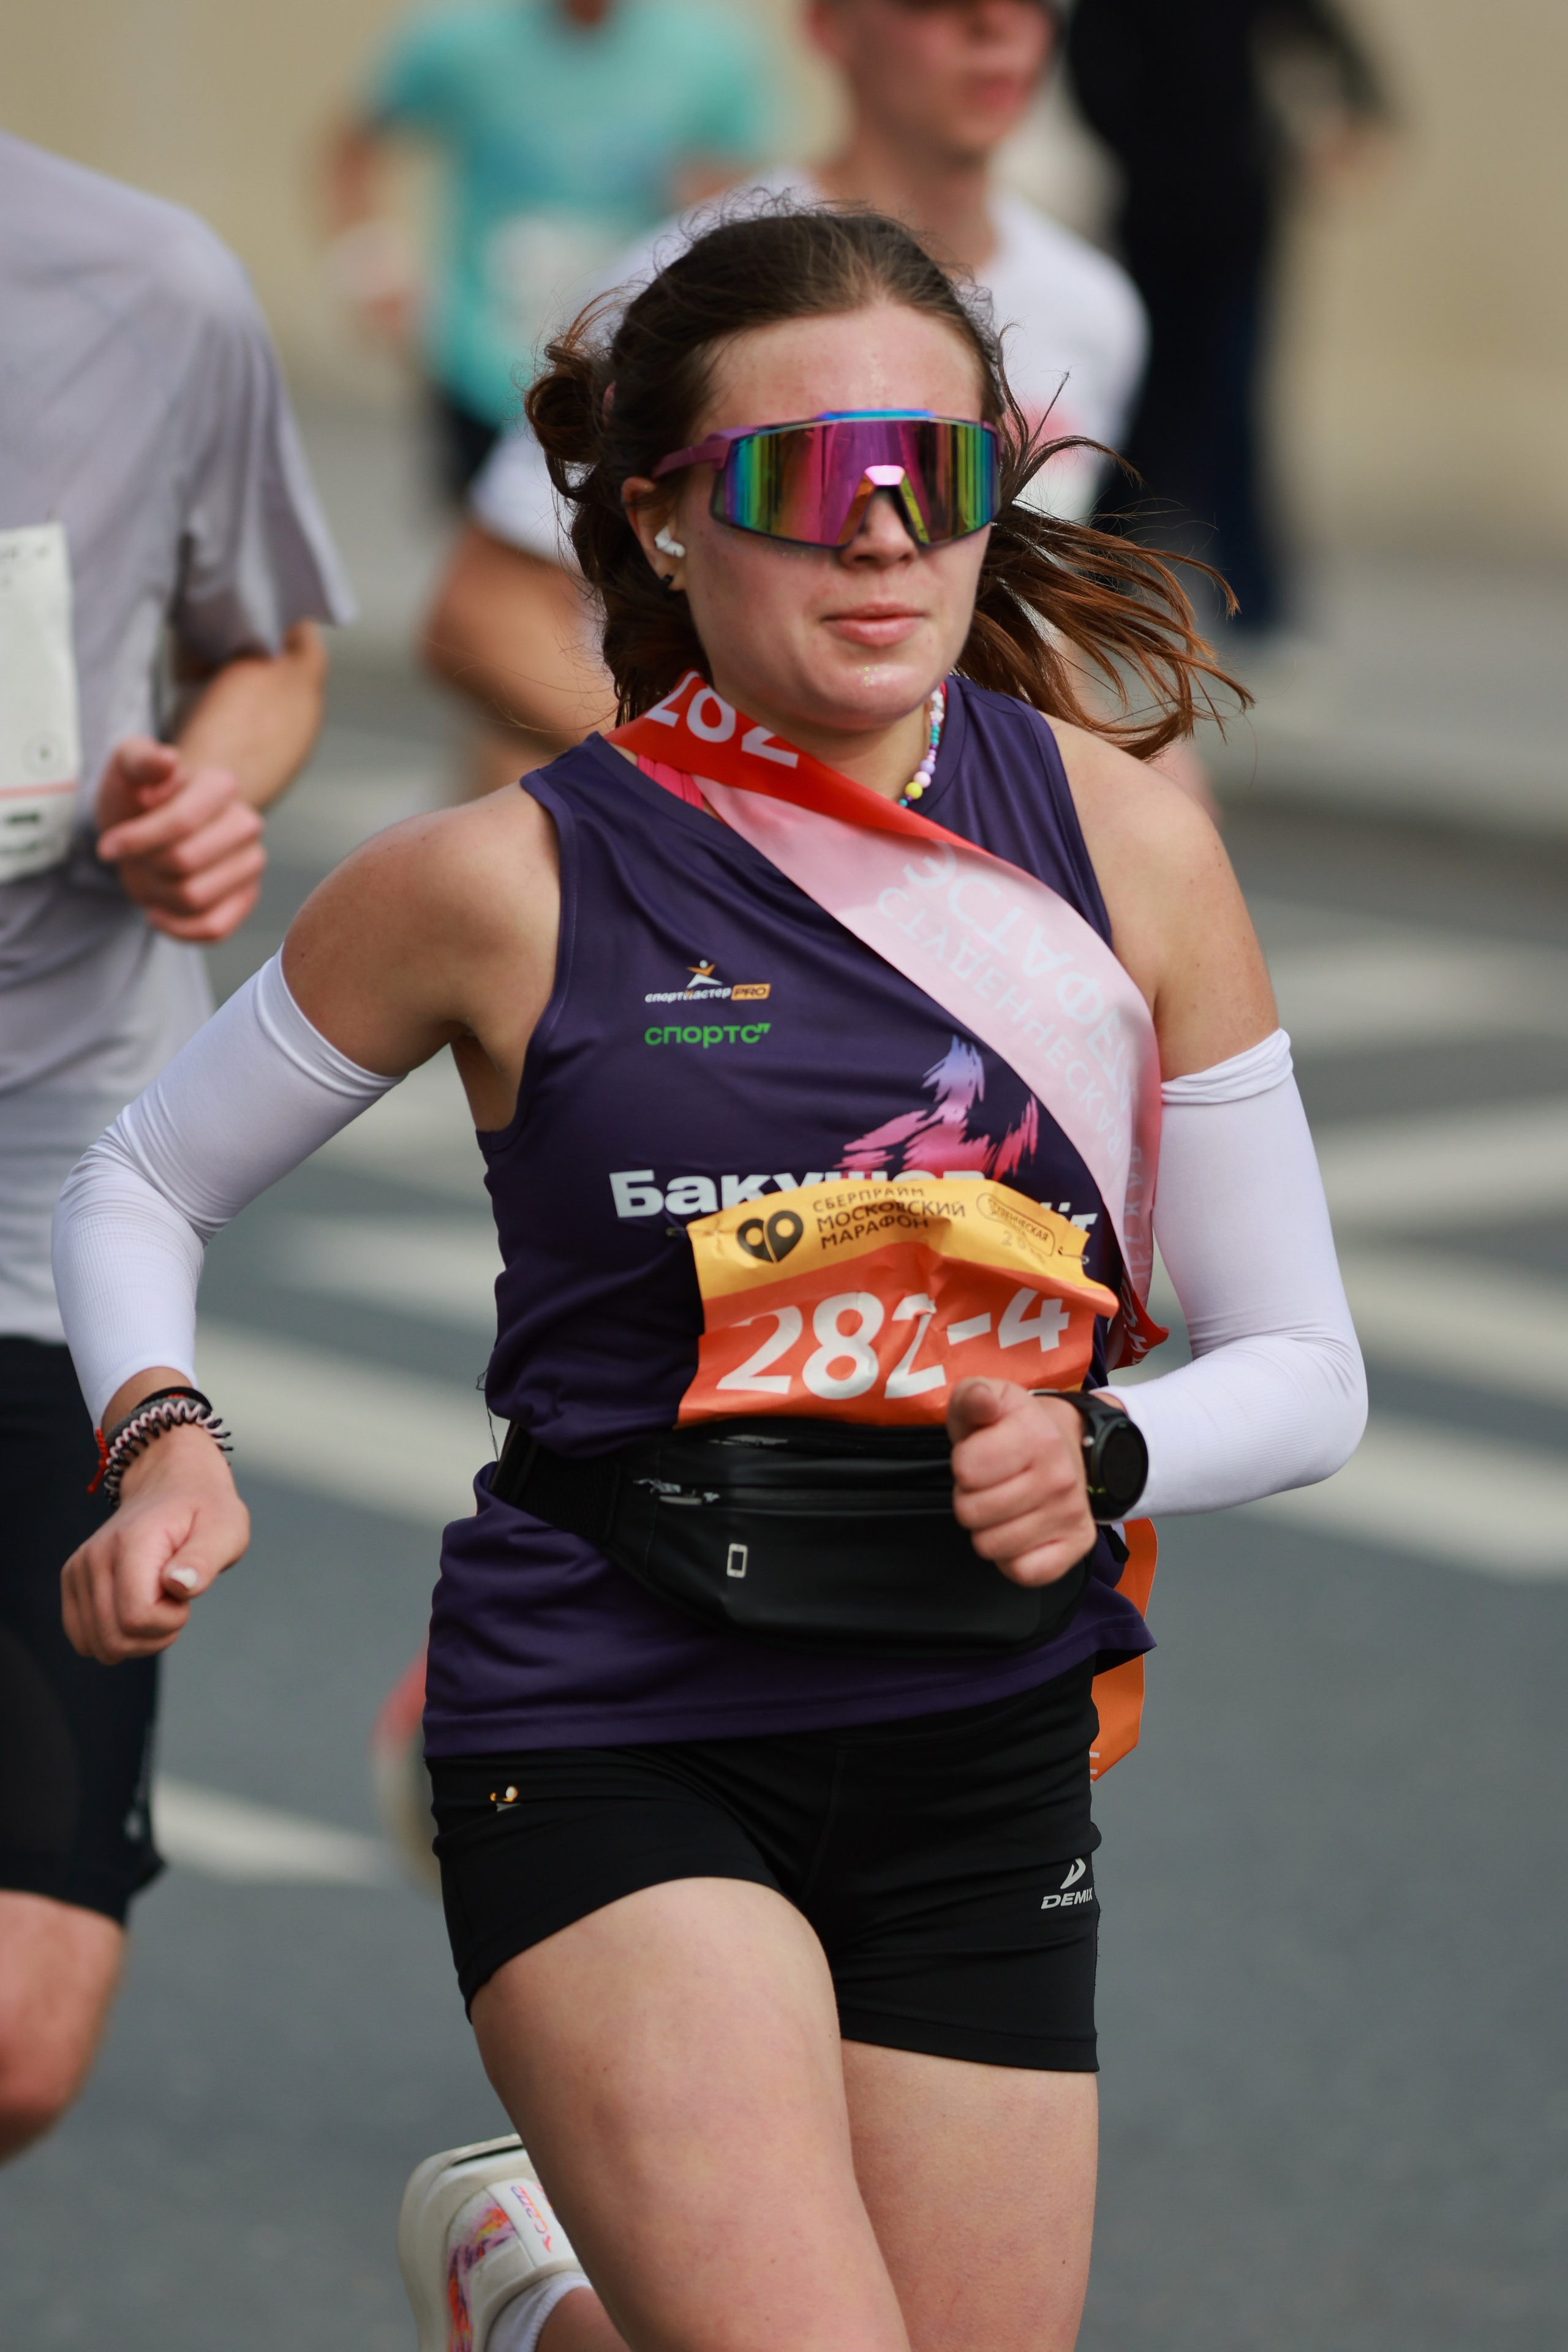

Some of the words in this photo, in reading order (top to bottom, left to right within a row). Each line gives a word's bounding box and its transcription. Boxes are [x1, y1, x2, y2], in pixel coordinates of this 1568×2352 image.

[735, 988, 766, 997] PRO
[813, 1186, 924, 1212] СБЕРПРАЙМ
[816, 1198, 966, 1233] МОСКОВСКИЙ
[820, 1215, 929, 1250] МАРАФОН
[716, 1287, 1070, 1400] 282-4
[1041, 1887, 1093, 1910] DEMIX
